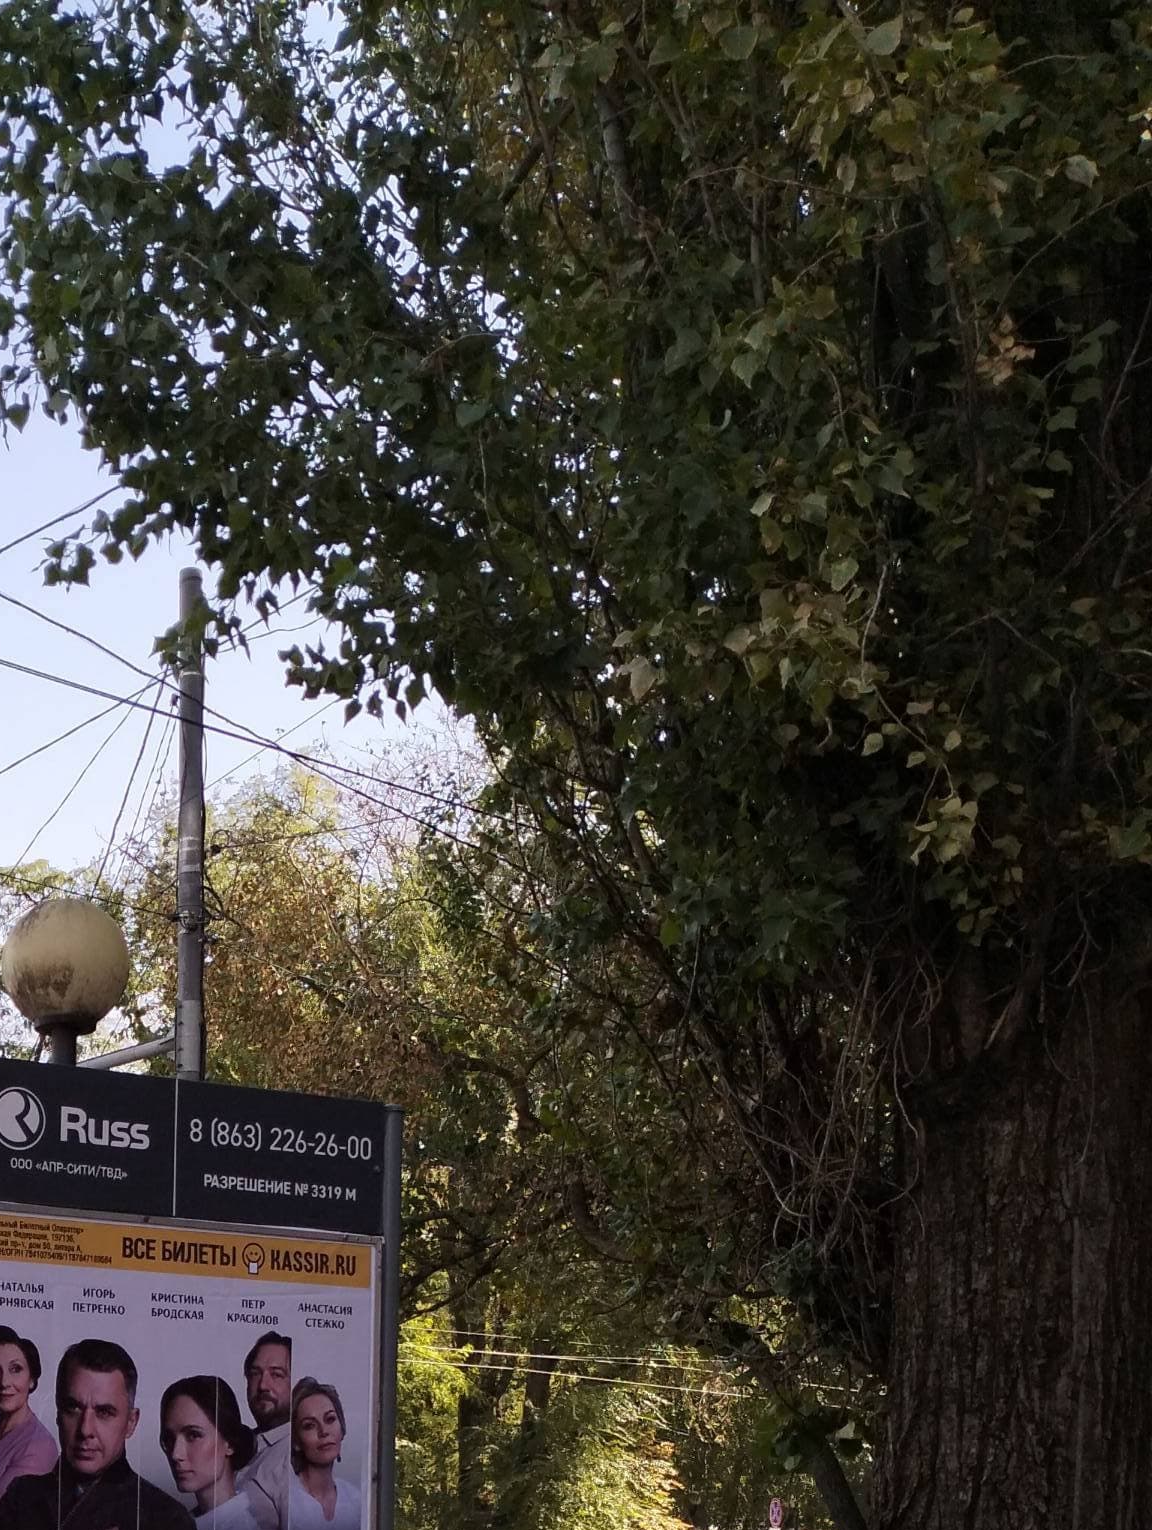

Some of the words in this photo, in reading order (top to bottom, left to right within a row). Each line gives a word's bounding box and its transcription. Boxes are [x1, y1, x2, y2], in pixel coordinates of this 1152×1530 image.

[60, 1105, 150, 1150] Russ
[190, 1118, 202, 1142] 8
[211, 1117, 262, 1151] (863)
[269, 1127, 372, 1160] 226-26-00
[35, 1160, 128, 1180] «АПР-СИТИ/ТВД»
[203, 1173, 291, 1196] РАЗРЕШЕНИЕ
[311, 1184, 342, 1200] 3319
[121, 1237, 156, 1260] ВСЕ
[161, 1240, 237, 1267] БИЛЕТЫ
[270, 1249, 357, 1277] KASSIR.RU
[82, 1287, 116, 1300] ИГОРЬ
[151, 1292, 205, 1306] КРИСТИНА
[72, 1302, 126, 1316] ПЕТРЕНКО
[241, 1299, 266, 1310] ПЕТР
[297, 1303, 353, 1316] АНАСТАСИЯ
[151, 1307, 204, 1321] БРОДСКАЯ
[227, 1312, 279, 1326] КРАСИЛОВ
[305, 1317, 345, 1330] СТЕЖКО
